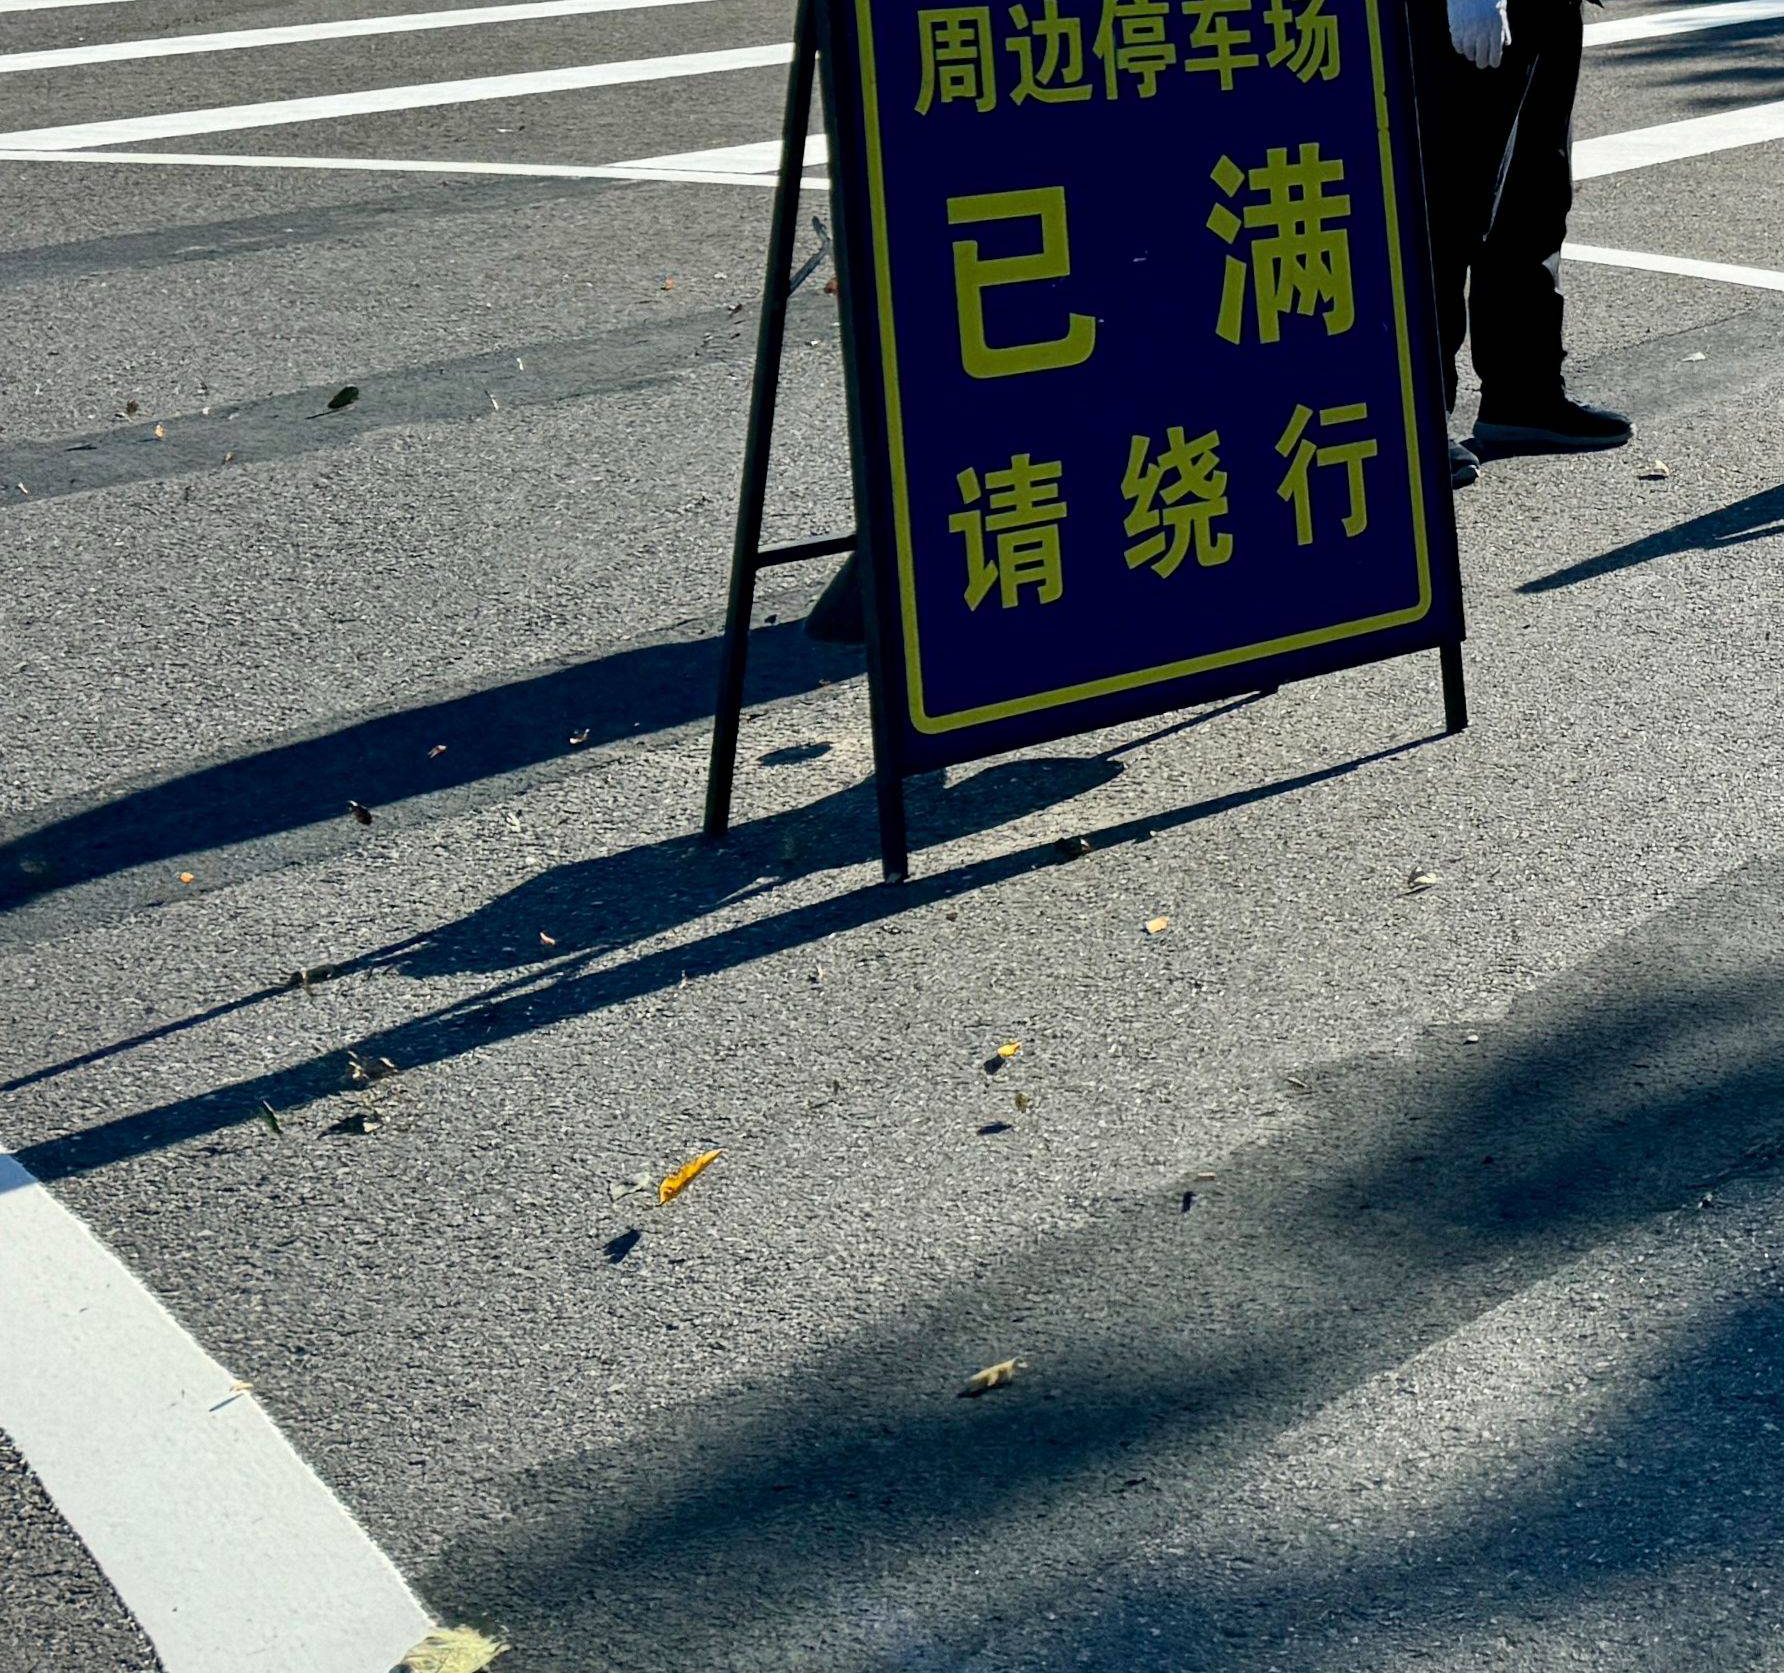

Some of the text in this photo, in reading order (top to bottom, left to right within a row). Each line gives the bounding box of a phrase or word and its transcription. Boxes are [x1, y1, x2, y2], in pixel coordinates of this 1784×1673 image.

[945, 142, 1357, 379] 已满
[948, 401, 1380, 612] 请绕行
